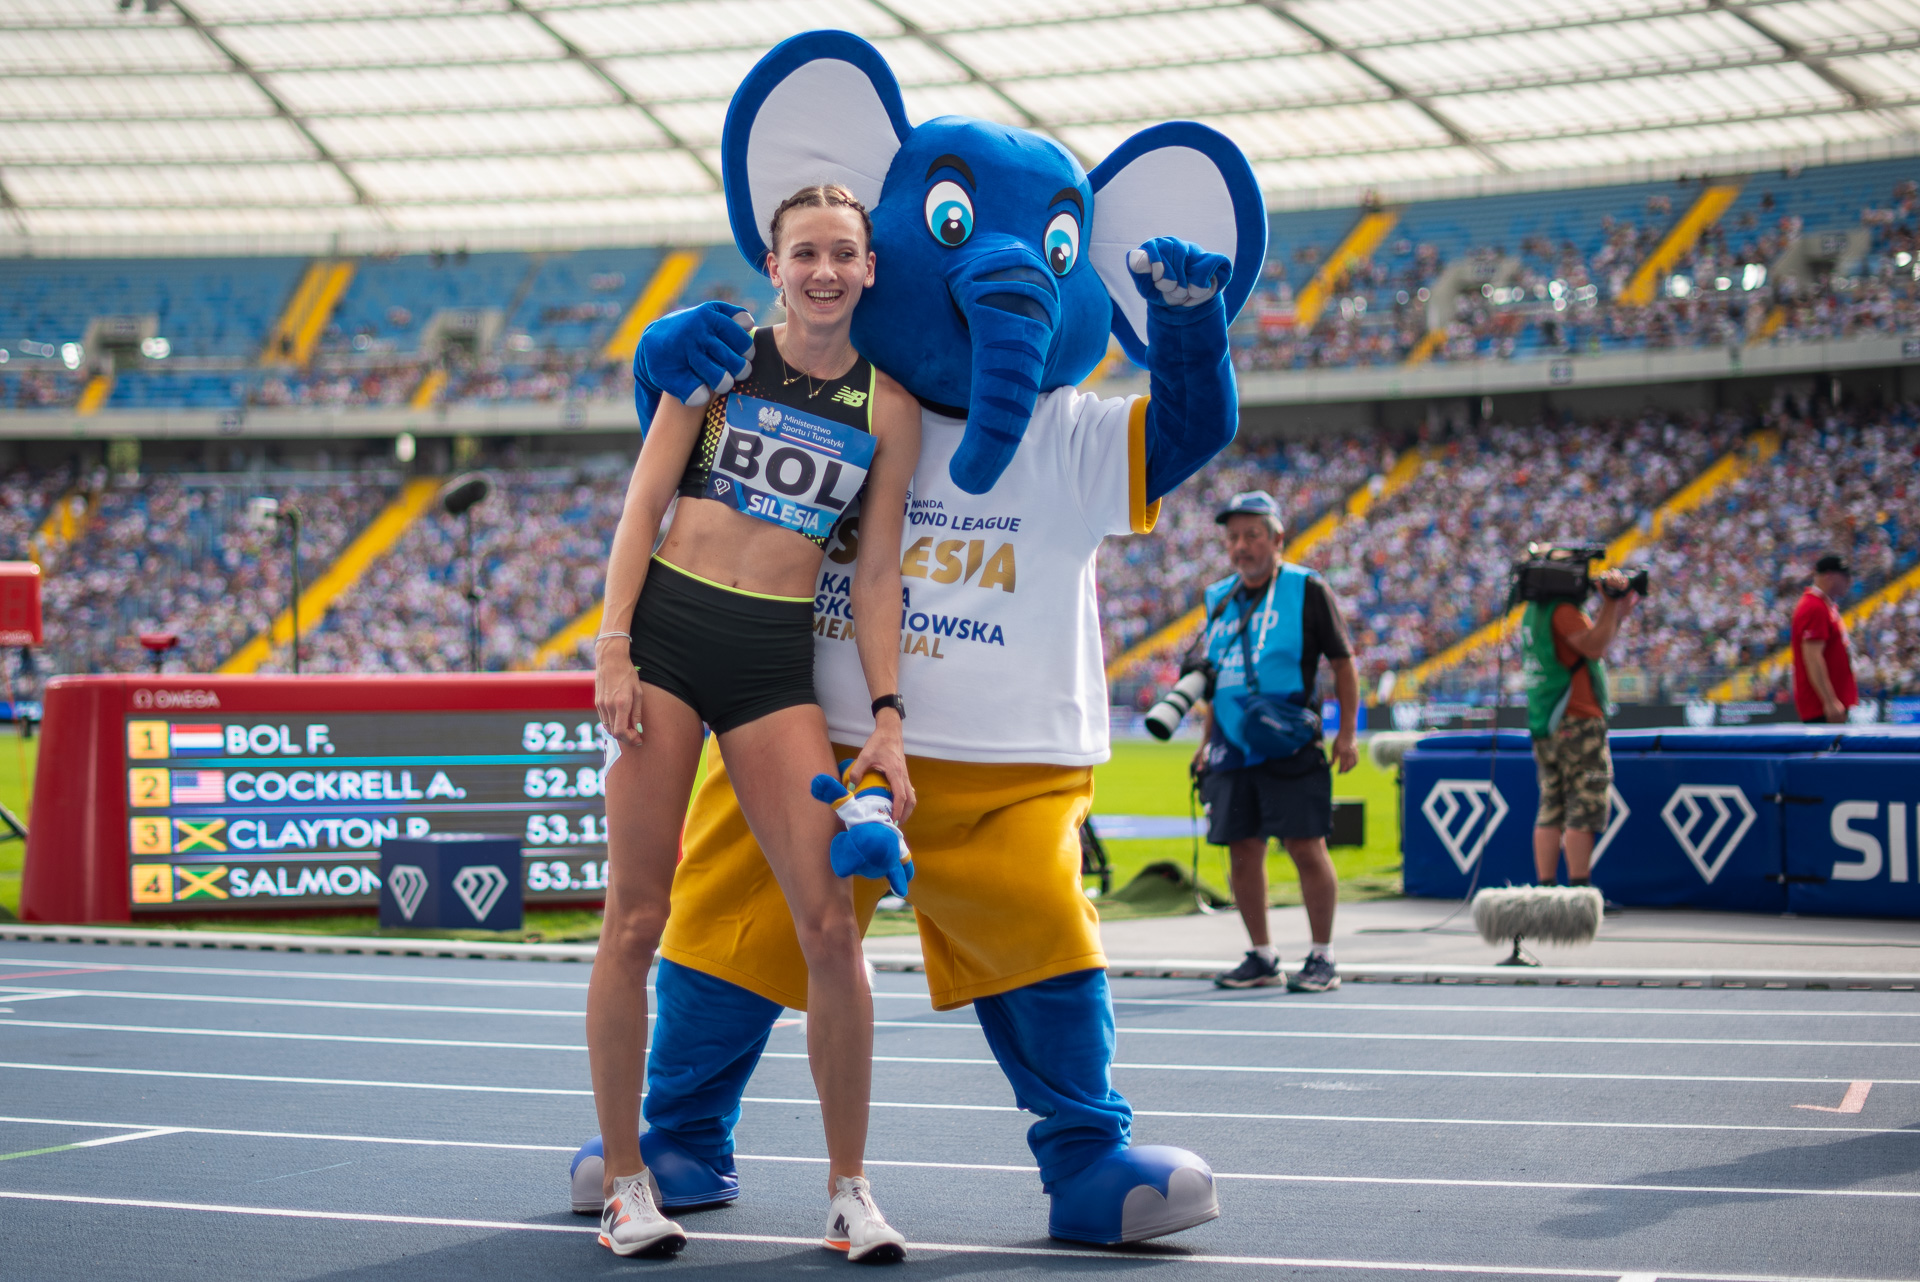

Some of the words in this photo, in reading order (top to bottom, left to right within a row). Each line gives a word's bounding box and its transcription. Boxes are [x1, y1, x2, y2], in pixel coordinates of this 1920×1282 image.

[781, 422, 807, 437] Sportu
[812, 431, 845, 449] Turystyki
[784, 414, 832, 435] Ministerstwo
[718, 427, 847, 511] BOL
[748, 494, 819, 530] SILESIA
[951, 515, 1022, 533] LEAGUE
[828, 516, 1017, 594] SESIA
[812, 614, 945, 659] MEMIAL
[142, 730, 155, 751] 1
[225, 724, 302, 755] BOL
[306, 723, 335, 755] F.
[141, 776, 158, 799] 2
[226, 769, 424, 802] COCKRELL
[424, 769, 467, 800] A.
[142, 824, 160, 847] 3
[226, 817, 399, 849] CLAYTON
[1831, 801, 1920, 883] SI
[228, 865, 382, 897] SALMON
